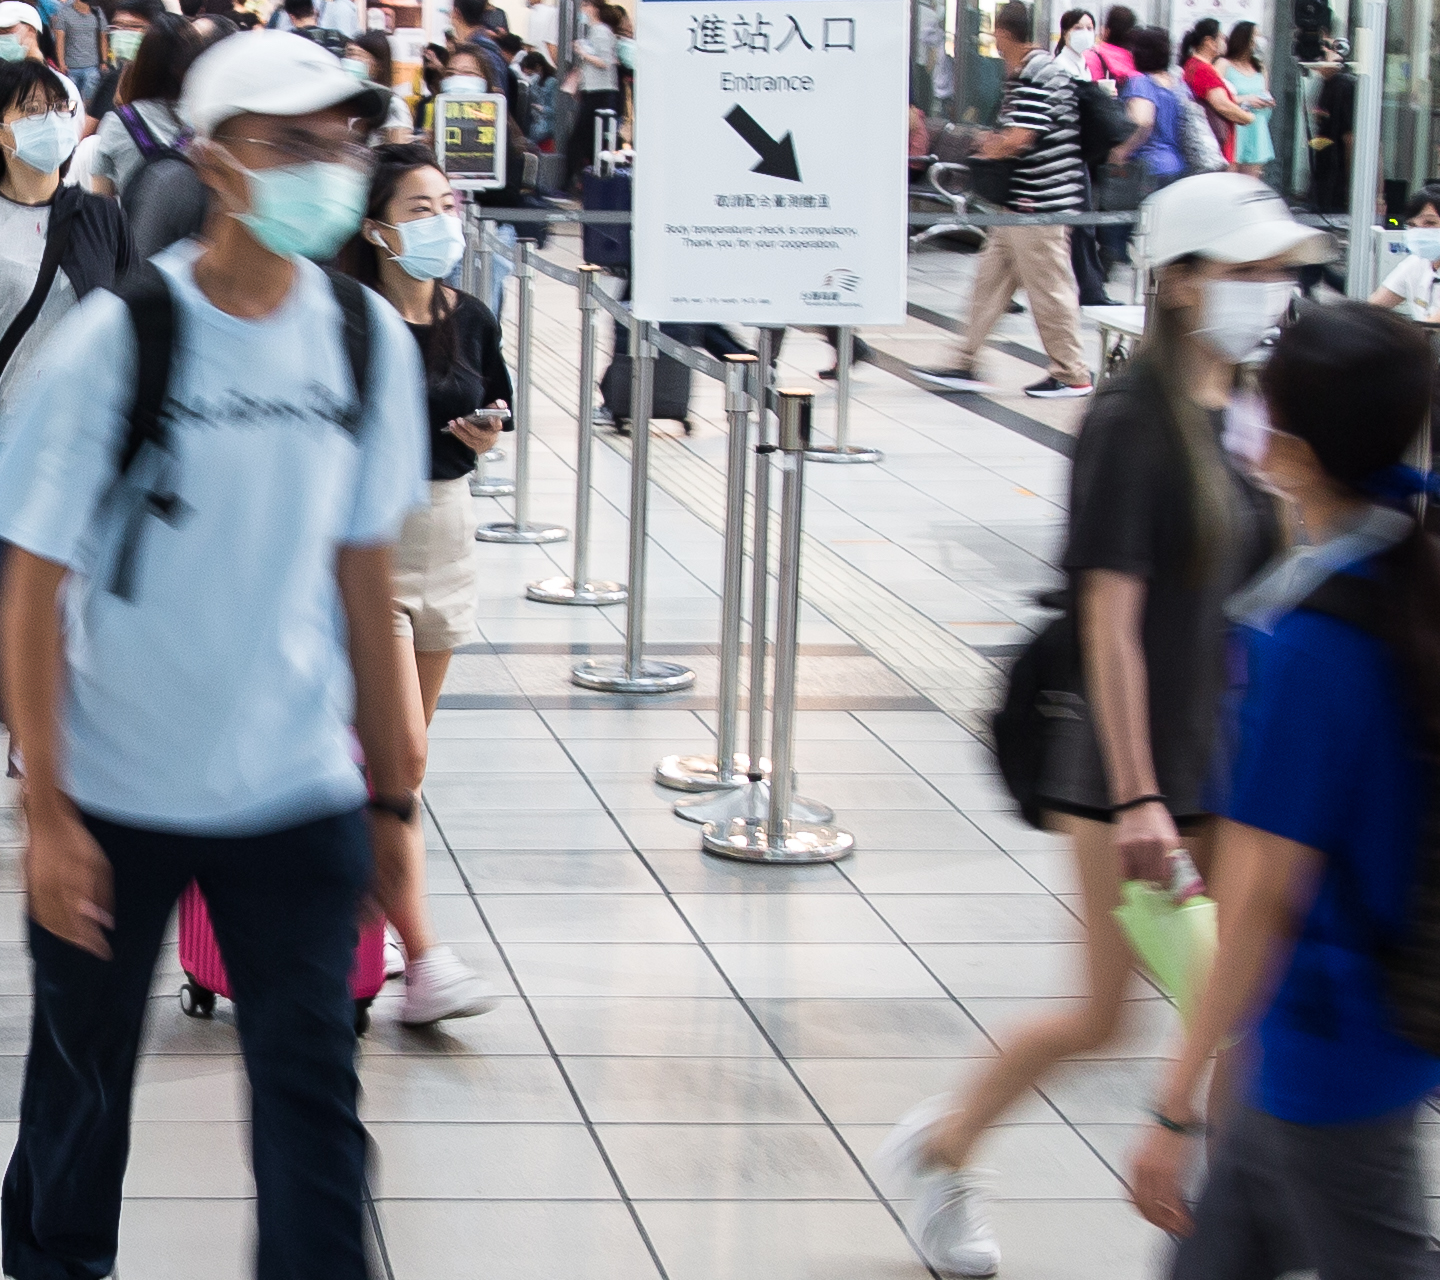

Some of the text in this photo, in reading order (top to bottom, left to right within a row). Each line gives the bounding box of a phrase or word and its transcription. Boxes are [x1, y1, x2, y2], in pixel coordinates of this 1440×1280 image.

[687, 12, 856, 55] 進站入口
[720, 71, 815, 94] Entrance
